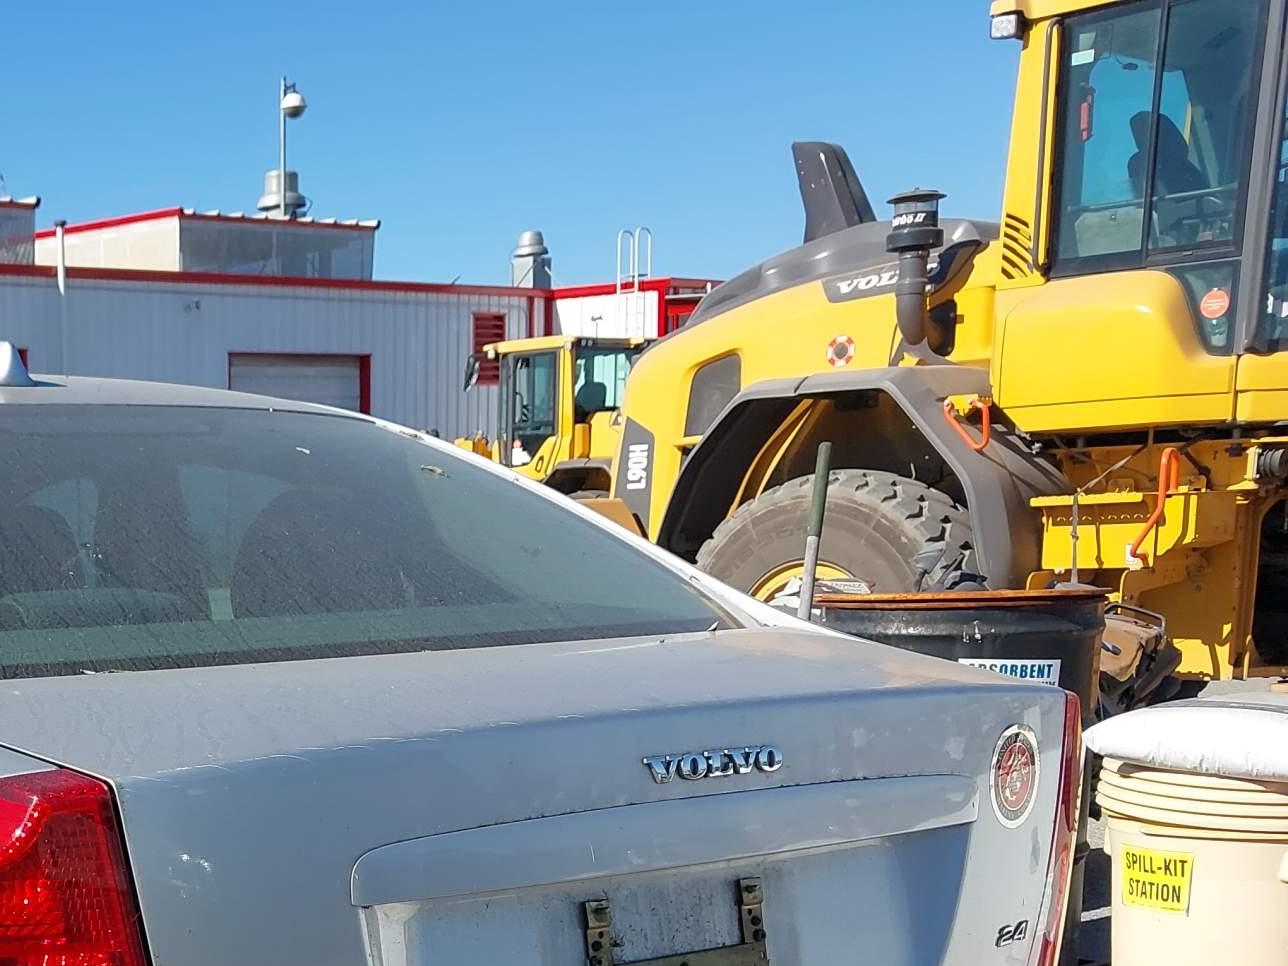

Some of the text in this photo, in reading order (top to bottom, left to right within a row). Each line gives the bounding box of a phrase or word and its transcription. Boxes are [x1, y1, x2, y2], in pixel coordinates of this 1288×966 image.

[626, 443, 649, 490] L90H
[641, 745, 784, 784] VOLVO
[1125, 851, 1188, 878] SPILL-KIT
[1128, 877, 1182, 903] STATION
